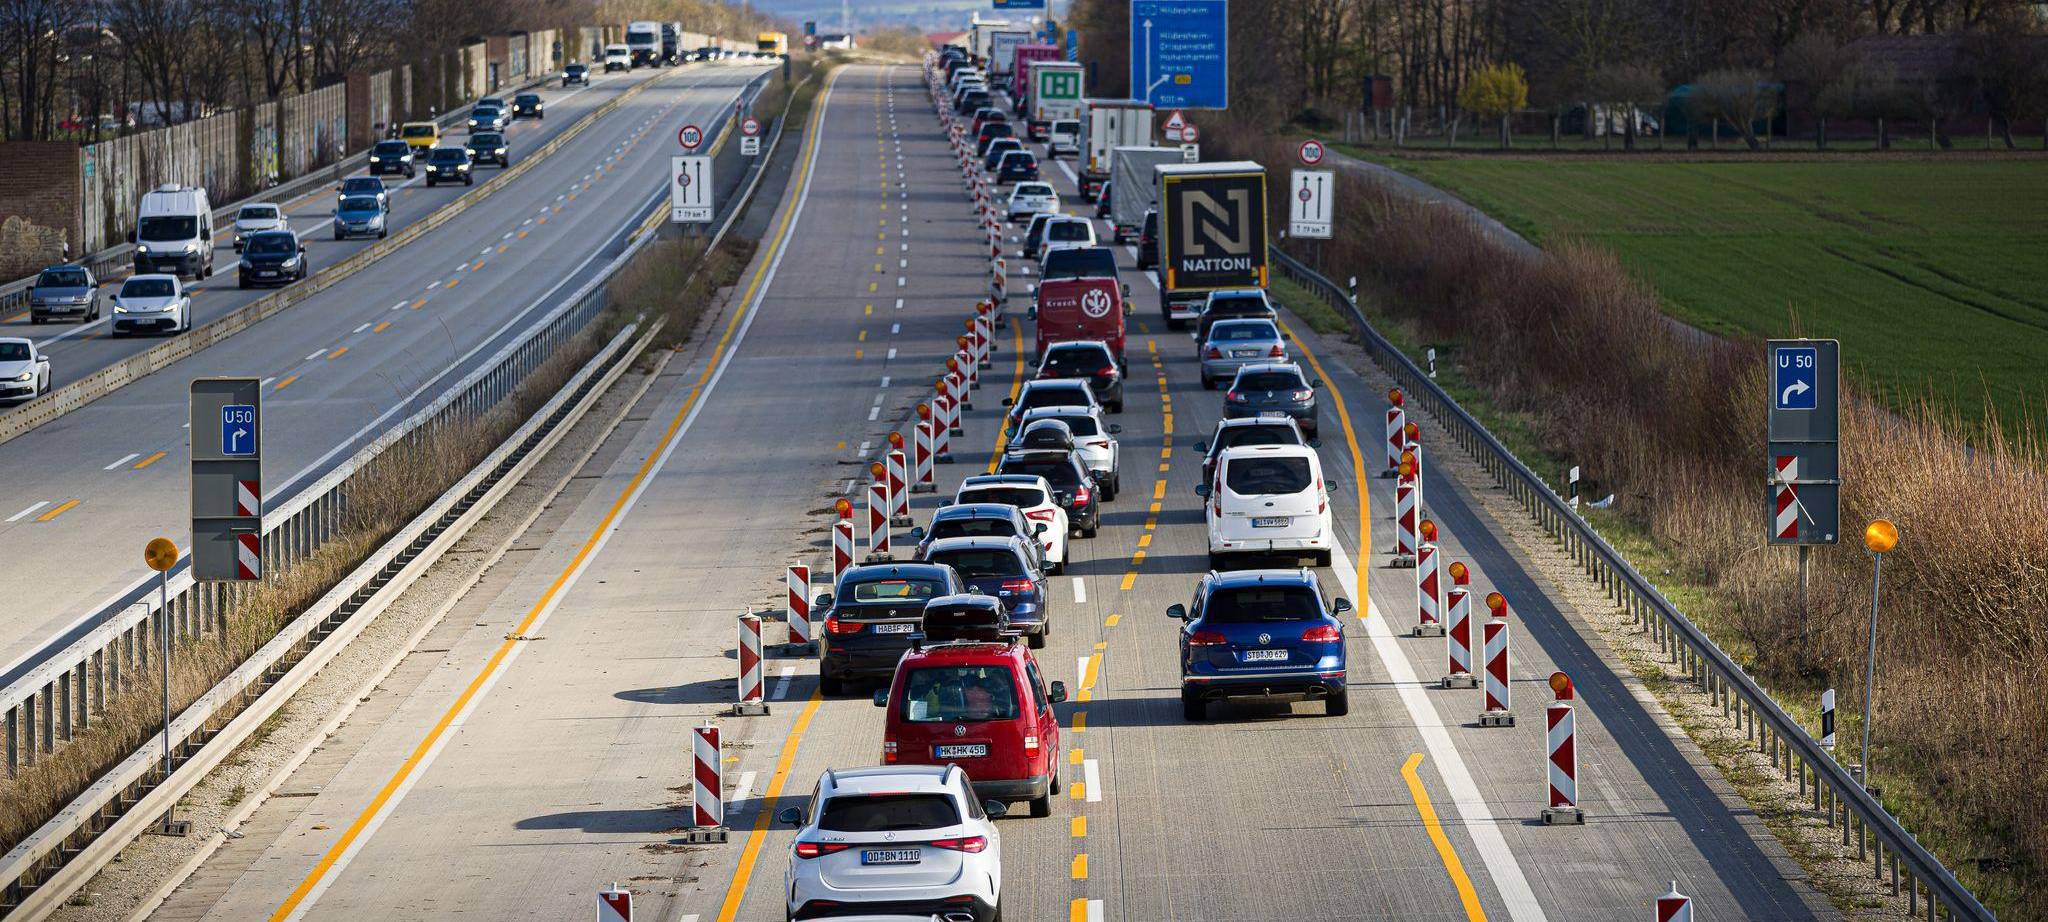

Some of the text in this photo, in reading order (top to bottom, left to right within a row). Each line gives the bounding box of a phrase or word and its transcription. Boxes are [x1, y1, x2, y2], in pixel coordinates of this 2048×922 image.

[684, 132, 698, 142] 100
[1183, 258, 1250, 272] NATTONI
[1779, 355, 1813, 368] U 50
[969, 745, 985, 754] 458
[884, 850, 897, 861] BN
[898, 850, 920, 861] 1110
